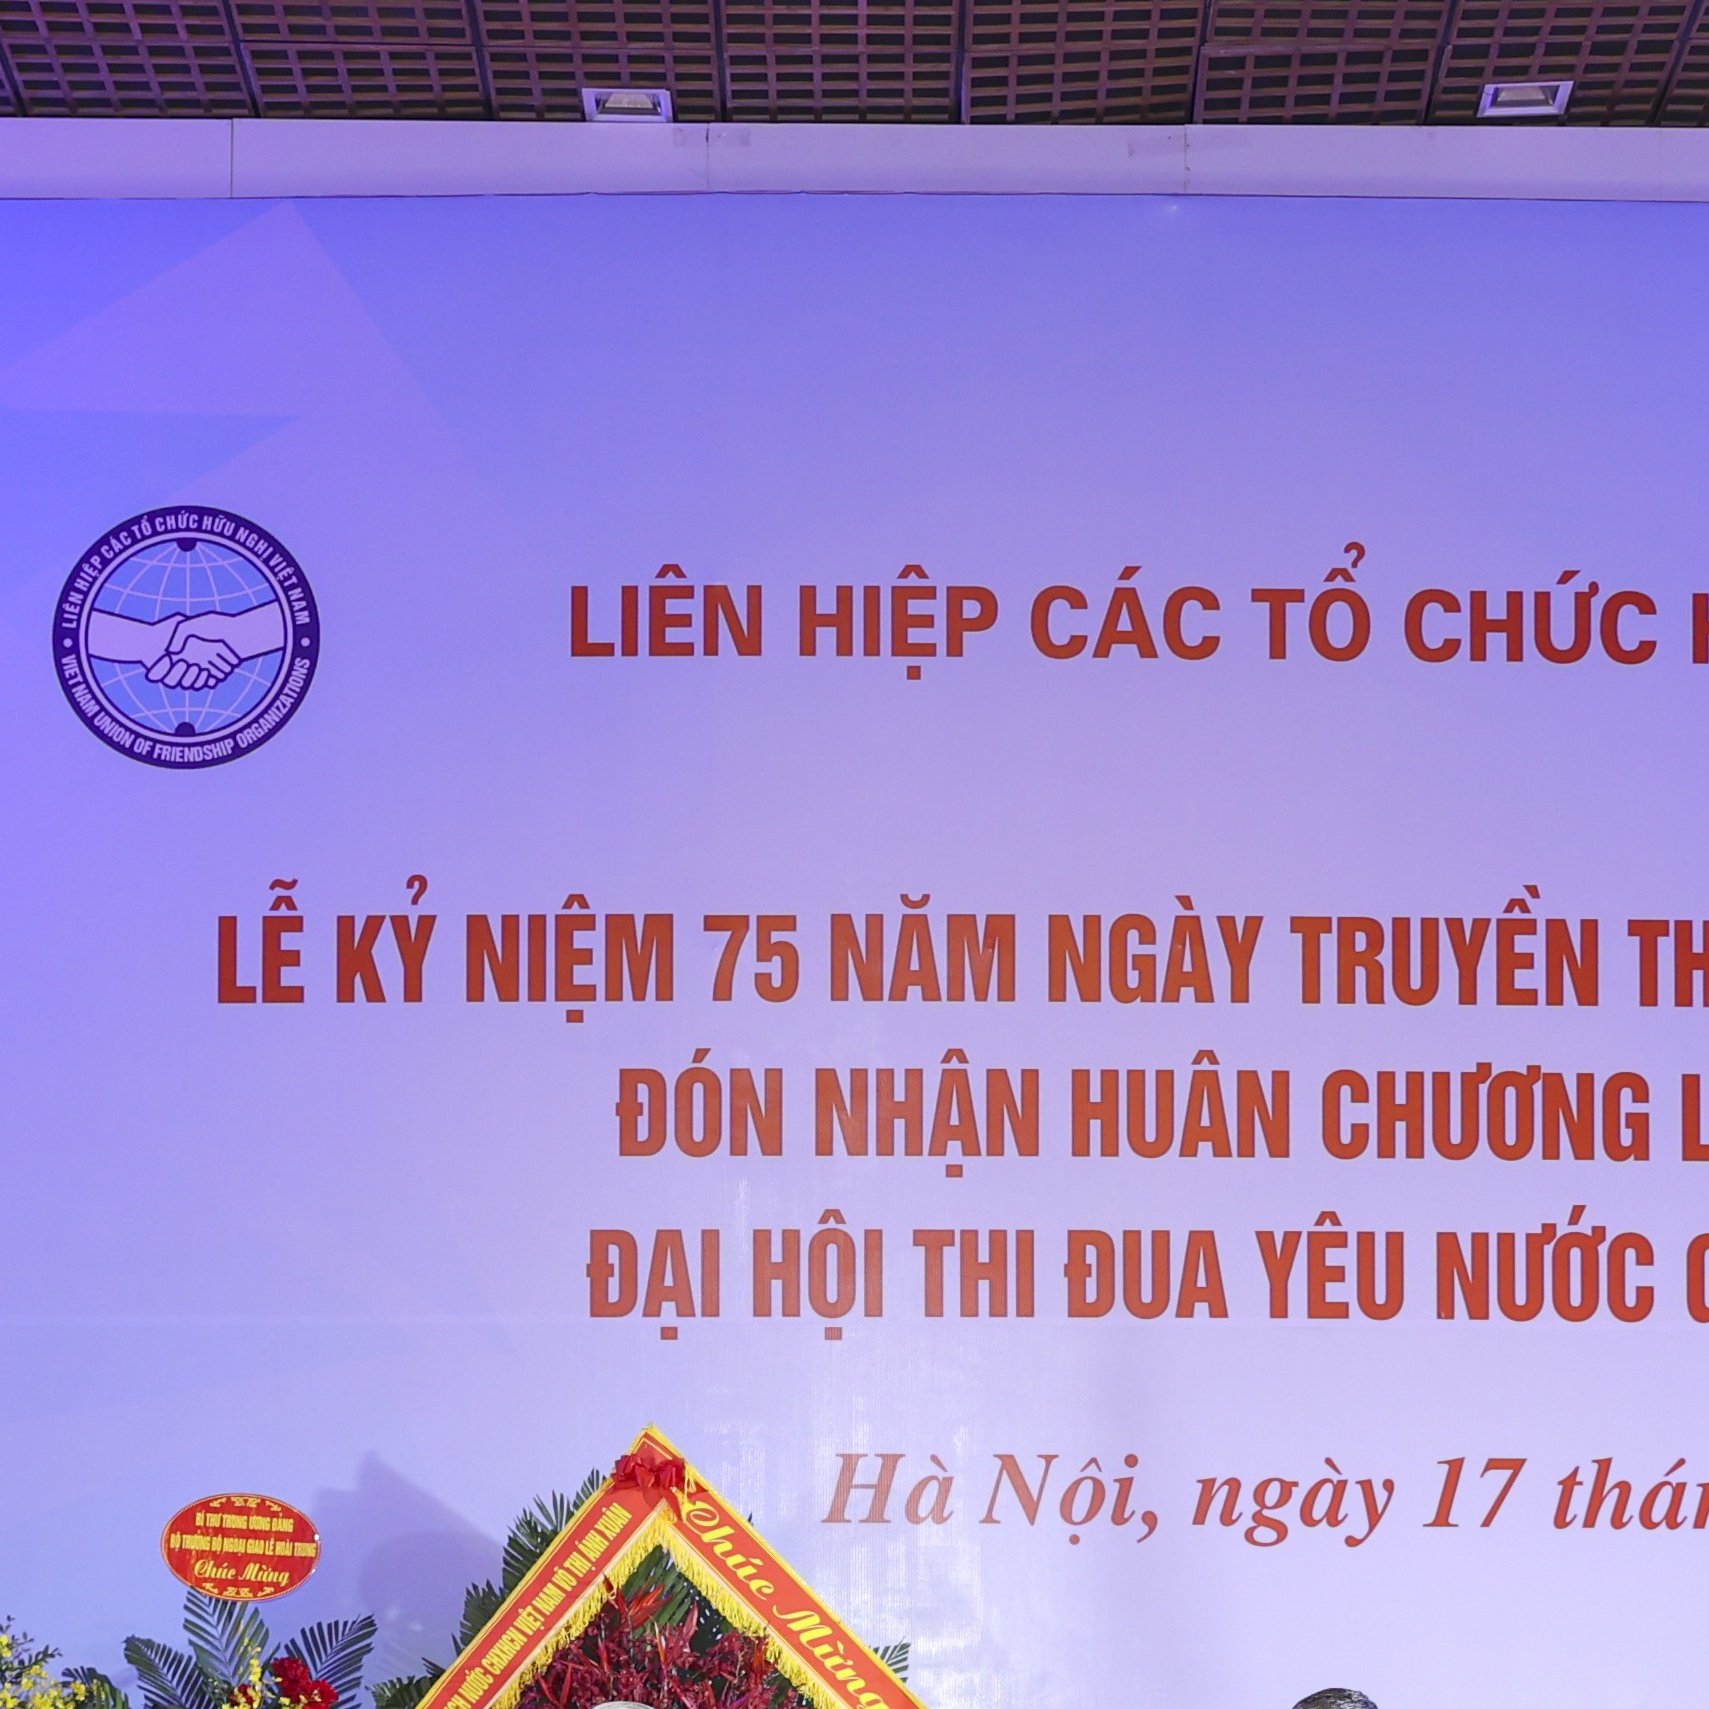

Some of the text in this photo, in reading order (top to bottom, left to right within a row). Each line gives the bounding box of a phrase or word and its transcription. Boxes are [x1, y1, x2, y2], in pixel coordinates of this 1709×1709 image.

[62, 510, 311, 628] LIÊN HIỆP CÁC TỔ CHỨC HỮU NGHỊ VIỆT NAM
[572, 564, 762, 657] LIÊN
[800, 564, 998, 681] HIỆP
[1031, 566, 1221, 661] CÁC
[1251, 542, 1371, 662] TỔ
[1405, 570, 1657, 665] CHỨC
[72, 684, 99, 717] NAM
[93, 712, 135, 749] UNION
[134, 740, 153, 757] OF
[153, 738, 235, 762] FRIENDSHIP
[236, 657, 310, 749] ORGANIZATIONS
[219, 880, 304, 1004] LỄ
[337, 874, 436, 1003] KỶ
[467, 893, 675, 1024] NIỆM
[704, 914, 800, 1004] 75
[830, 895, 1017, 1003] NĂM
[1047, 895, 1265, 1005] NGÀY
[1289, 884, 1599, 1008] TRUYỀN
[615, 1048, 784, 1158] ĐÓN
[815, 1048, 1041, 1179] NHẬN
[1071, 1049, 1291, 1160] HUÂN
[1321, 1061, 1651, 1163] CHƯƠNG
[586, 1228, 721, 1341] ĐẠI
[752, 1208, 884, 1341] HỘI
[913, 1228, 1036, 1319] THI
[1063, 1228, 1229, 1320] ĐUA
[1255, 1210, 1405, 1322] YÊU
[1436, 1203, 1655, 1324] NƯỚC
[206, 1513, 221, 1528] THƯ
[222, 1514, 248, 1529] TRUNG
[593, 1502, 633, 1541] XUÂN
[822, 1451, 954, 1525] Hà
[980, 1453, 1159, 1545] Nội,
[1192, 1457, 1395, 1549] ngày
[1426, 1456, 1528, 1528] 17
[194, 1559, 290, 1586] Chúc Mừng
[247, 1539, 264, 1555] GIAO
[265, 1538, 275, 1556] LÊ
[563, 1551, 597, 1579] THỊ
[683, 1500, 775, 1601] Chúc
[532, 1580, 566, 1616] NAM
[551, 1566, 578, 1594] VÕ
[481, 1620, 529, 1675] CHXHCN
[513, 1607, 546, 1637] VIỆT
